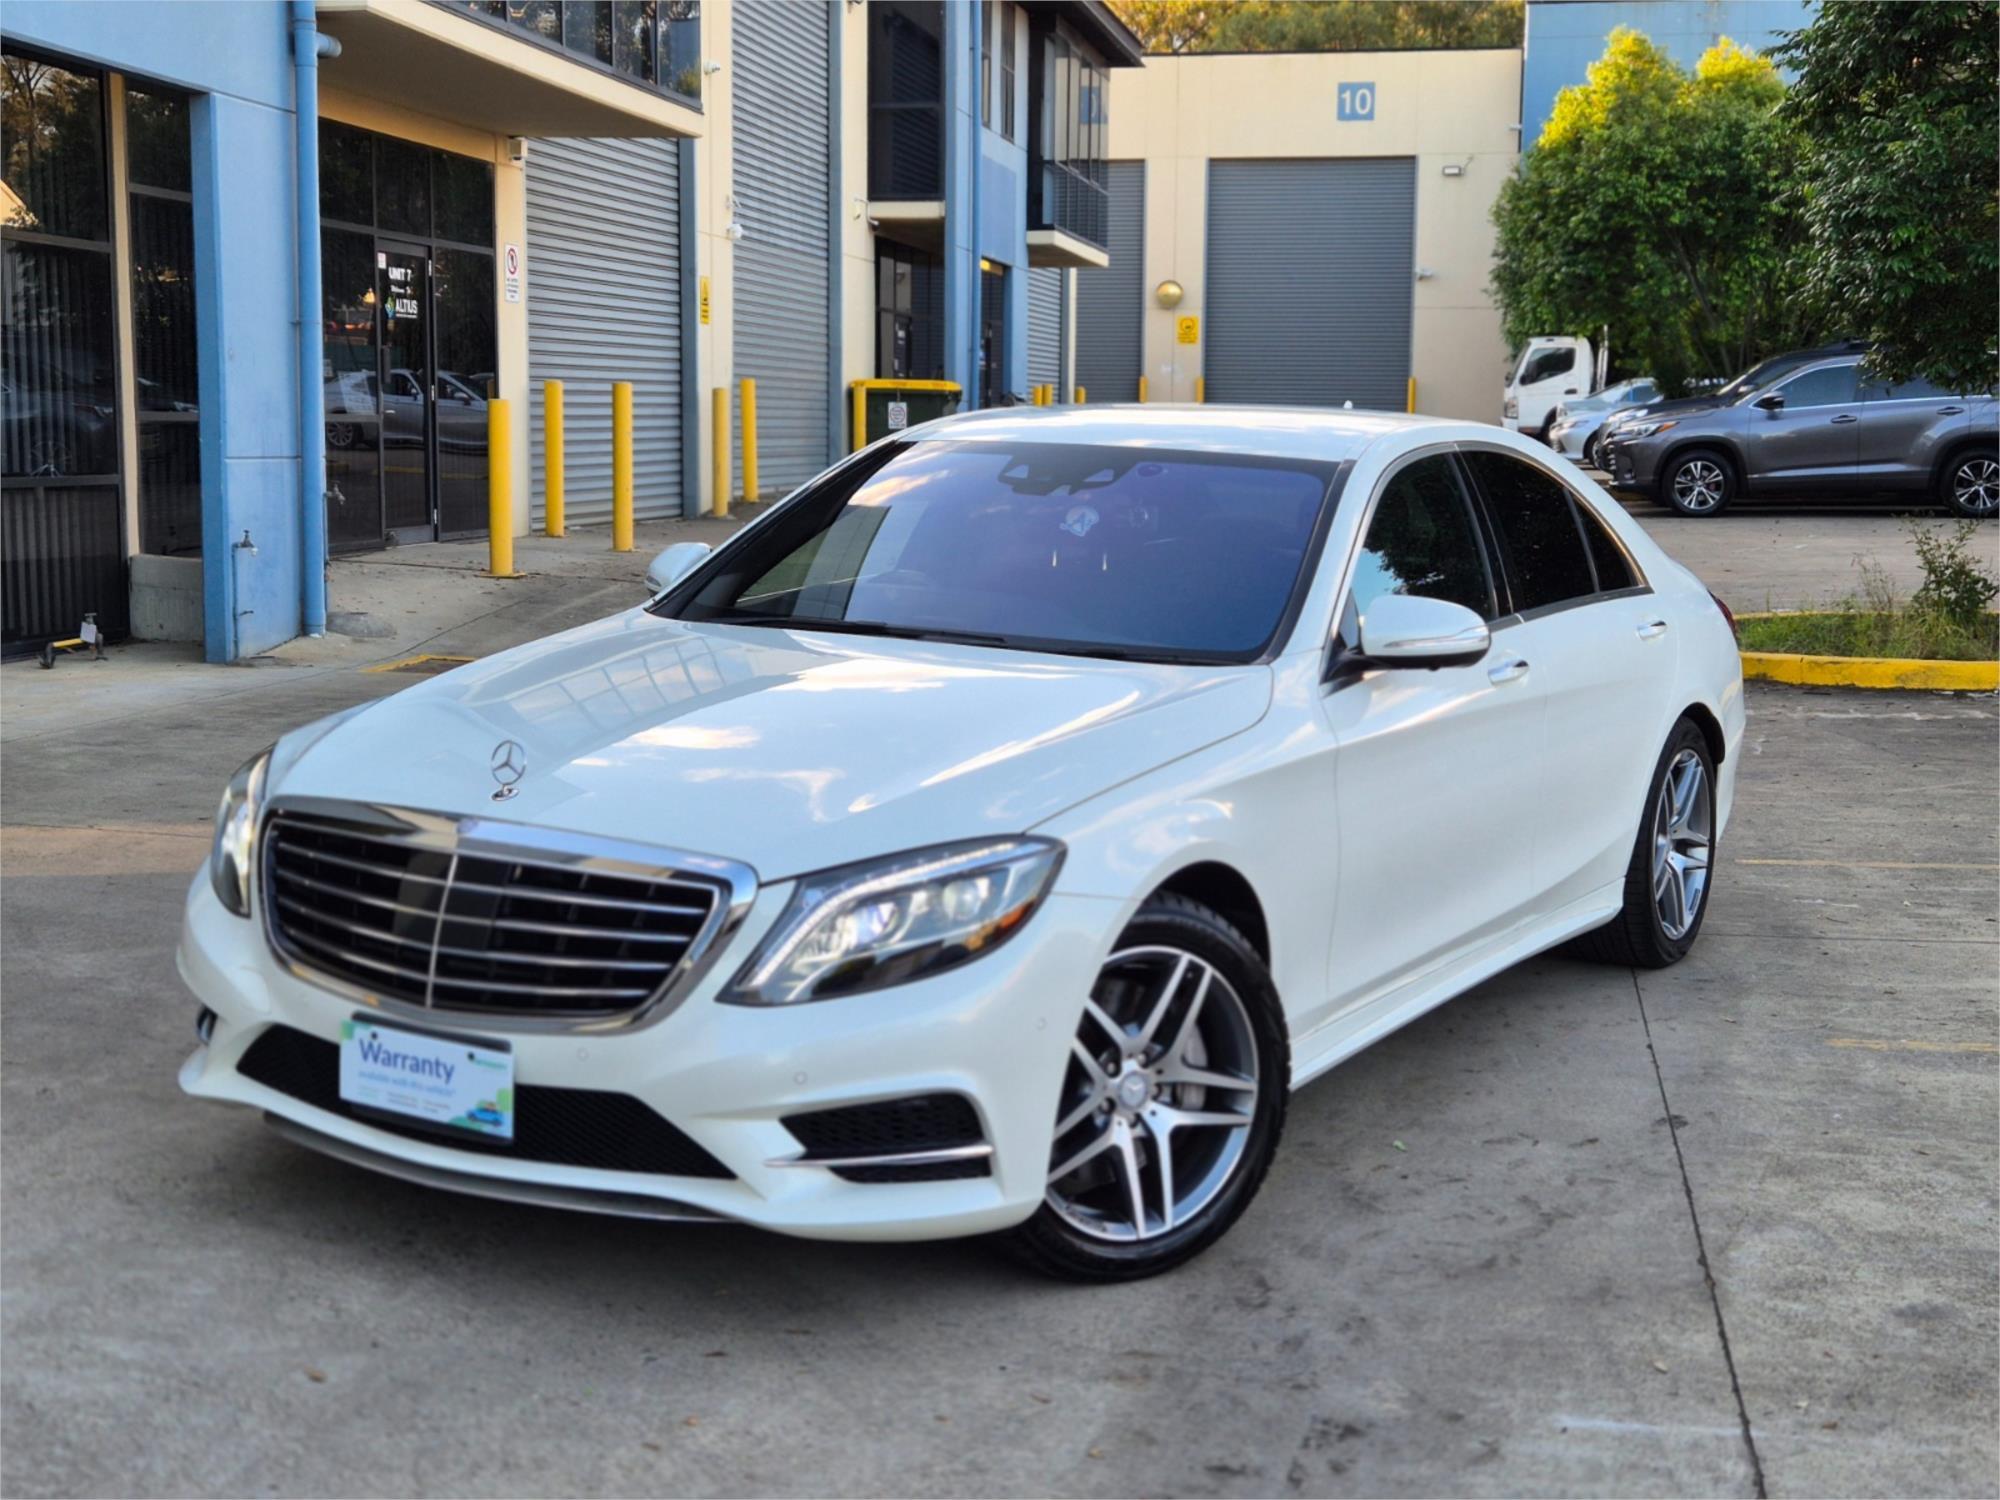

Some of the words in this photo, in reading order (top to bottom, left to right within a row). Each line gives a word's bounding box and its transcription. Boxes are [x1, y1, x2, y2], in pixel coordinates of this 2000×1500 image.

[1340, 88, 1371, 115] 10
[388, 266, 405, 281] UNIT
[358, 1037, 455, 1085] Warranty
